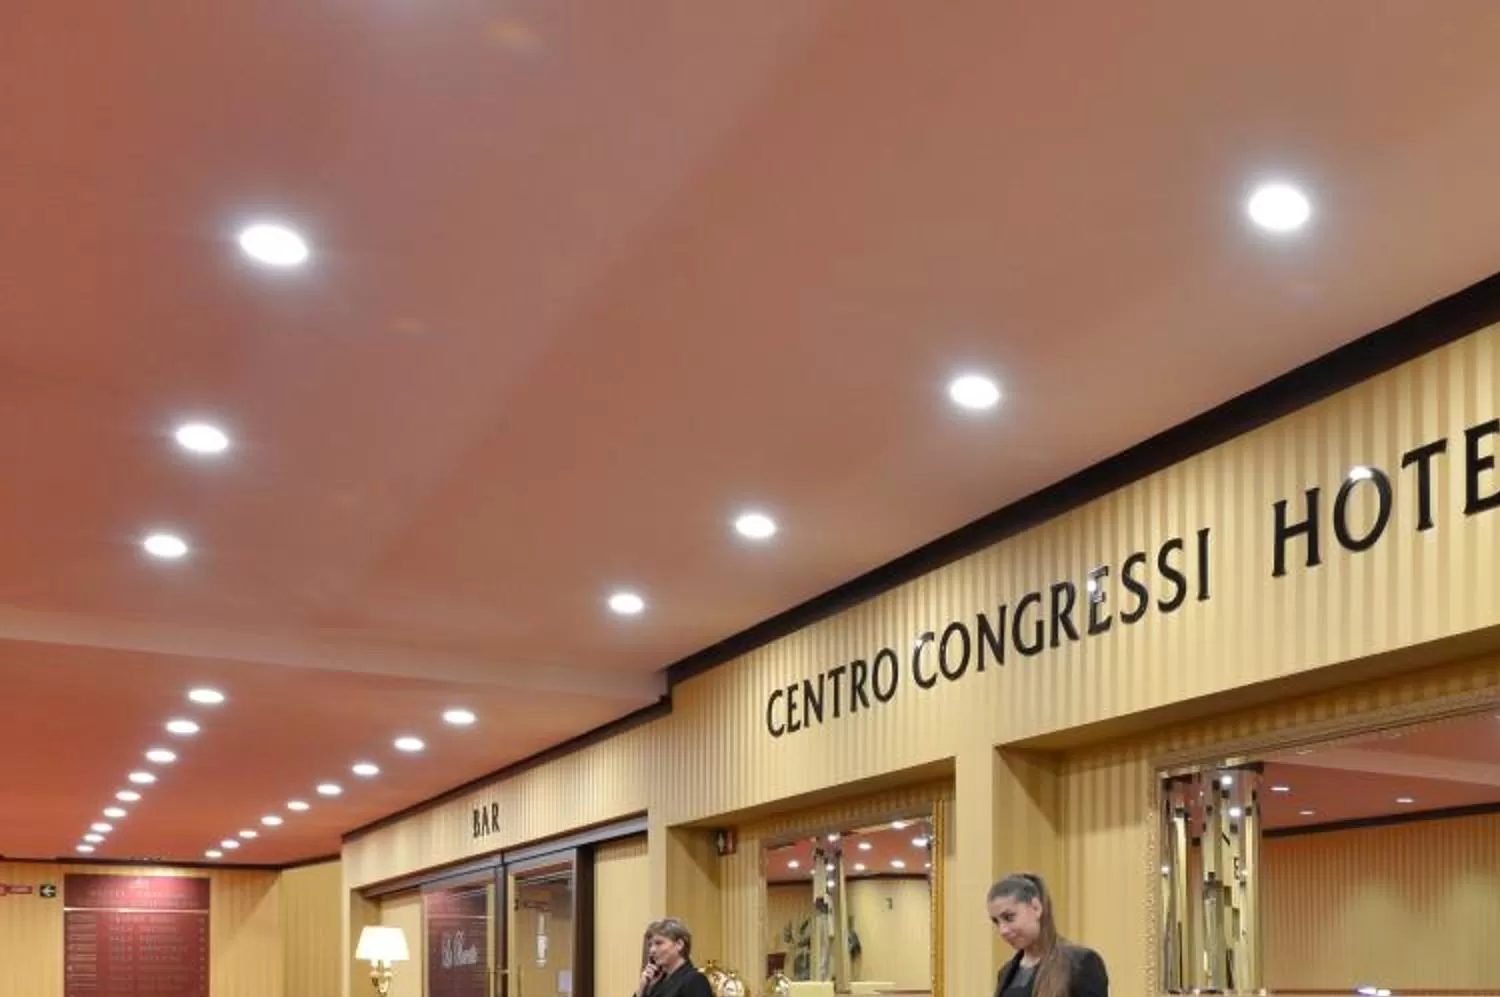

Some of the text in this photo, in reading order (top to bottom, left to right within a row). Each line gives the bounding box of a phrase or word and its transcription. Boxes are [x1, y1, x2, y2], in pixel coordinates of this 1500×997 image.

[766, 648, 899, 738] CENTRO
[911, 528, 1211, 689] CONGRESSI
[473, 802, 501, 838] BAR
